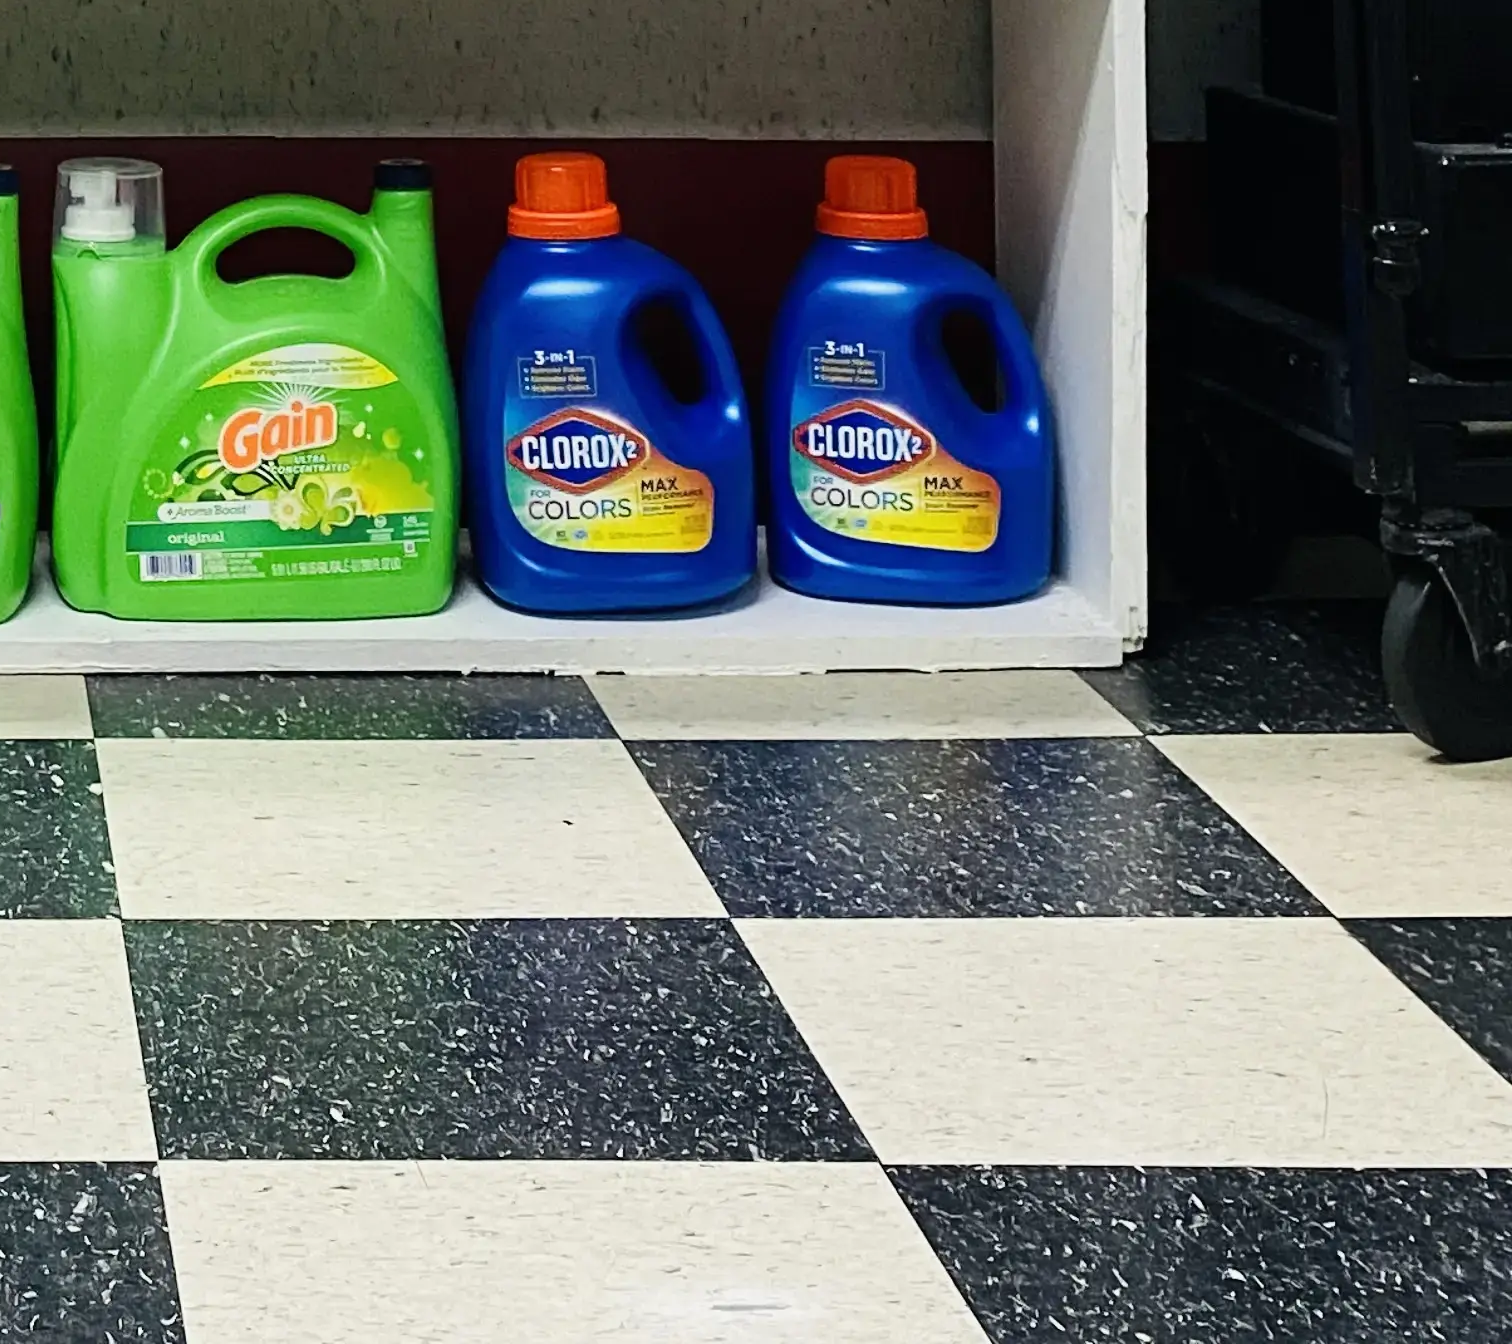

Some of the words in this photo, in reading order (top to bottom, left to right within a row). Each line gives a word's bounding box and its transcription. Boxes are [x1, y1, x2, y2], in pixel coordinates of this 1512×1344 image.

[221, 400, 335, 470] Gain
[294, 454, 327, 463] ULTRA
[269, 463, 351, 475] CONCENTRATED
[640, 477, 679, 493] MAX
[812, 475, 835, 486] FOR
[924, 476, 964, 491] MAX
[529, 489, 551, 499] FOR
[810, 487, 914, 512] COLORS
[215, 504, 248, 517] Boost
[528, 498, 633, 521] COLORS
[167, 530, 225, 546] original
